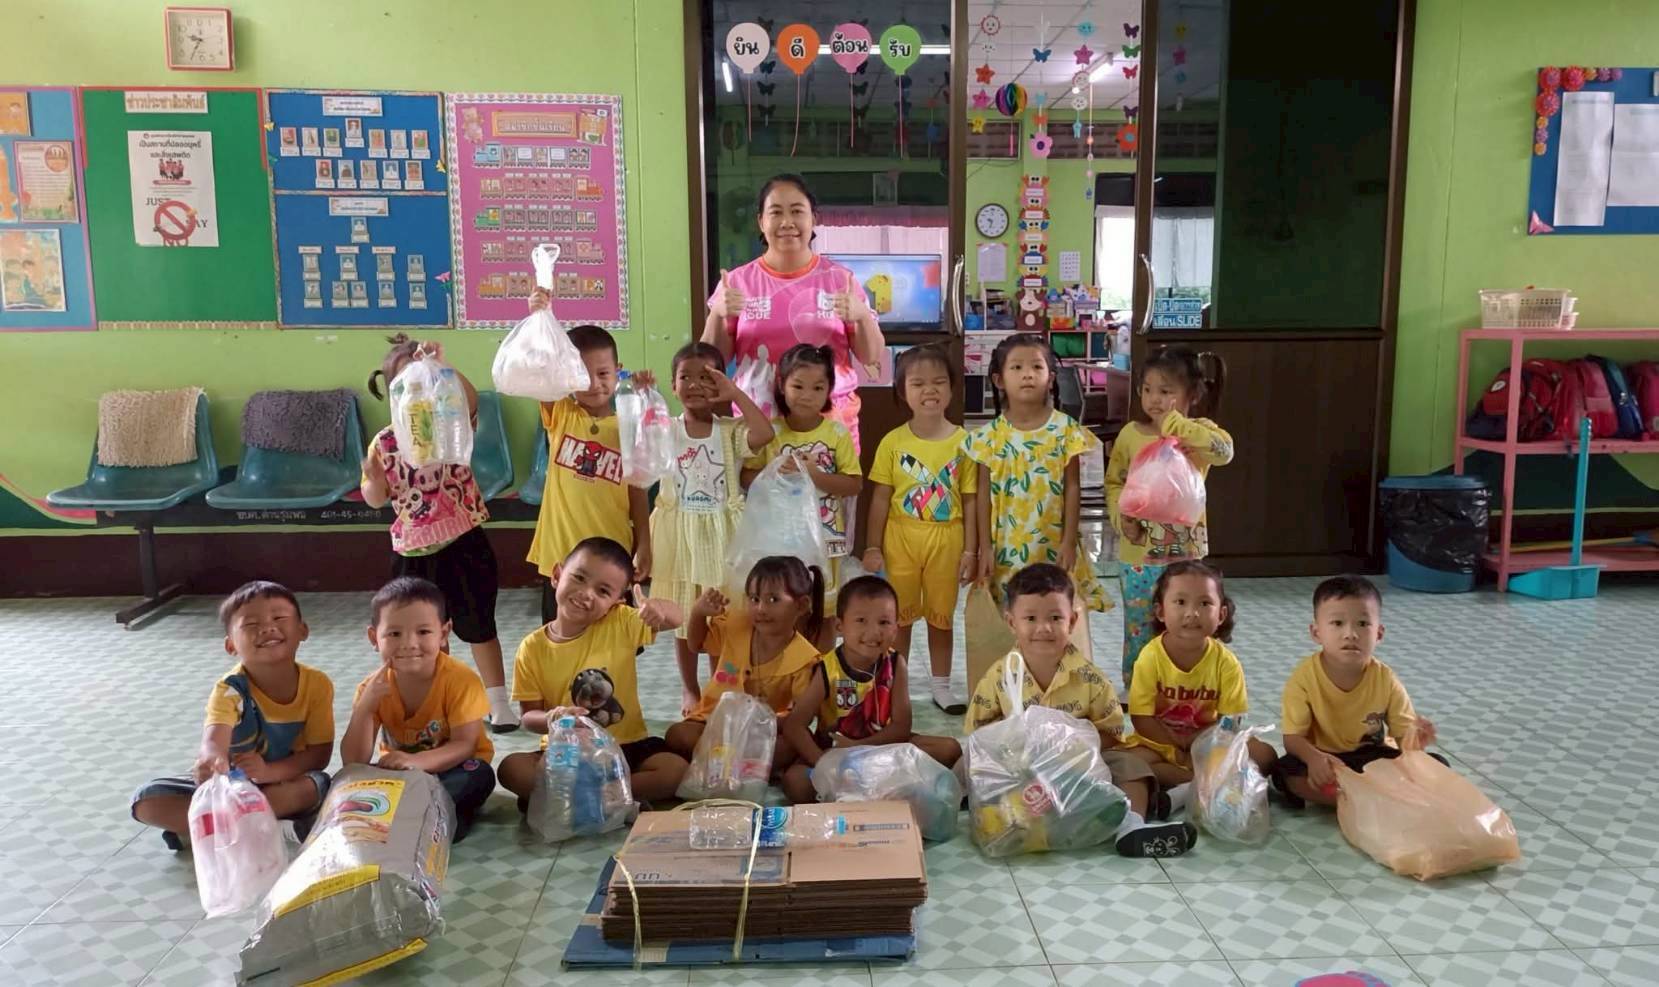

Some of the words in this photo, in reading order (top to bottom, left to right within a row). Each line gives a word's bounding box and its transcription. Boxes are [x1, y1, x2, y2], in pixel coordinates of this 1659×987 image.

[734, 36, 760, 55] ยิน
[790, 38, 804, 57] ดี
[832, 32, 869, 53] ต้อน
[889, 39, 911, 57] รับ
[560, 436, 623, 485] MAVEL
